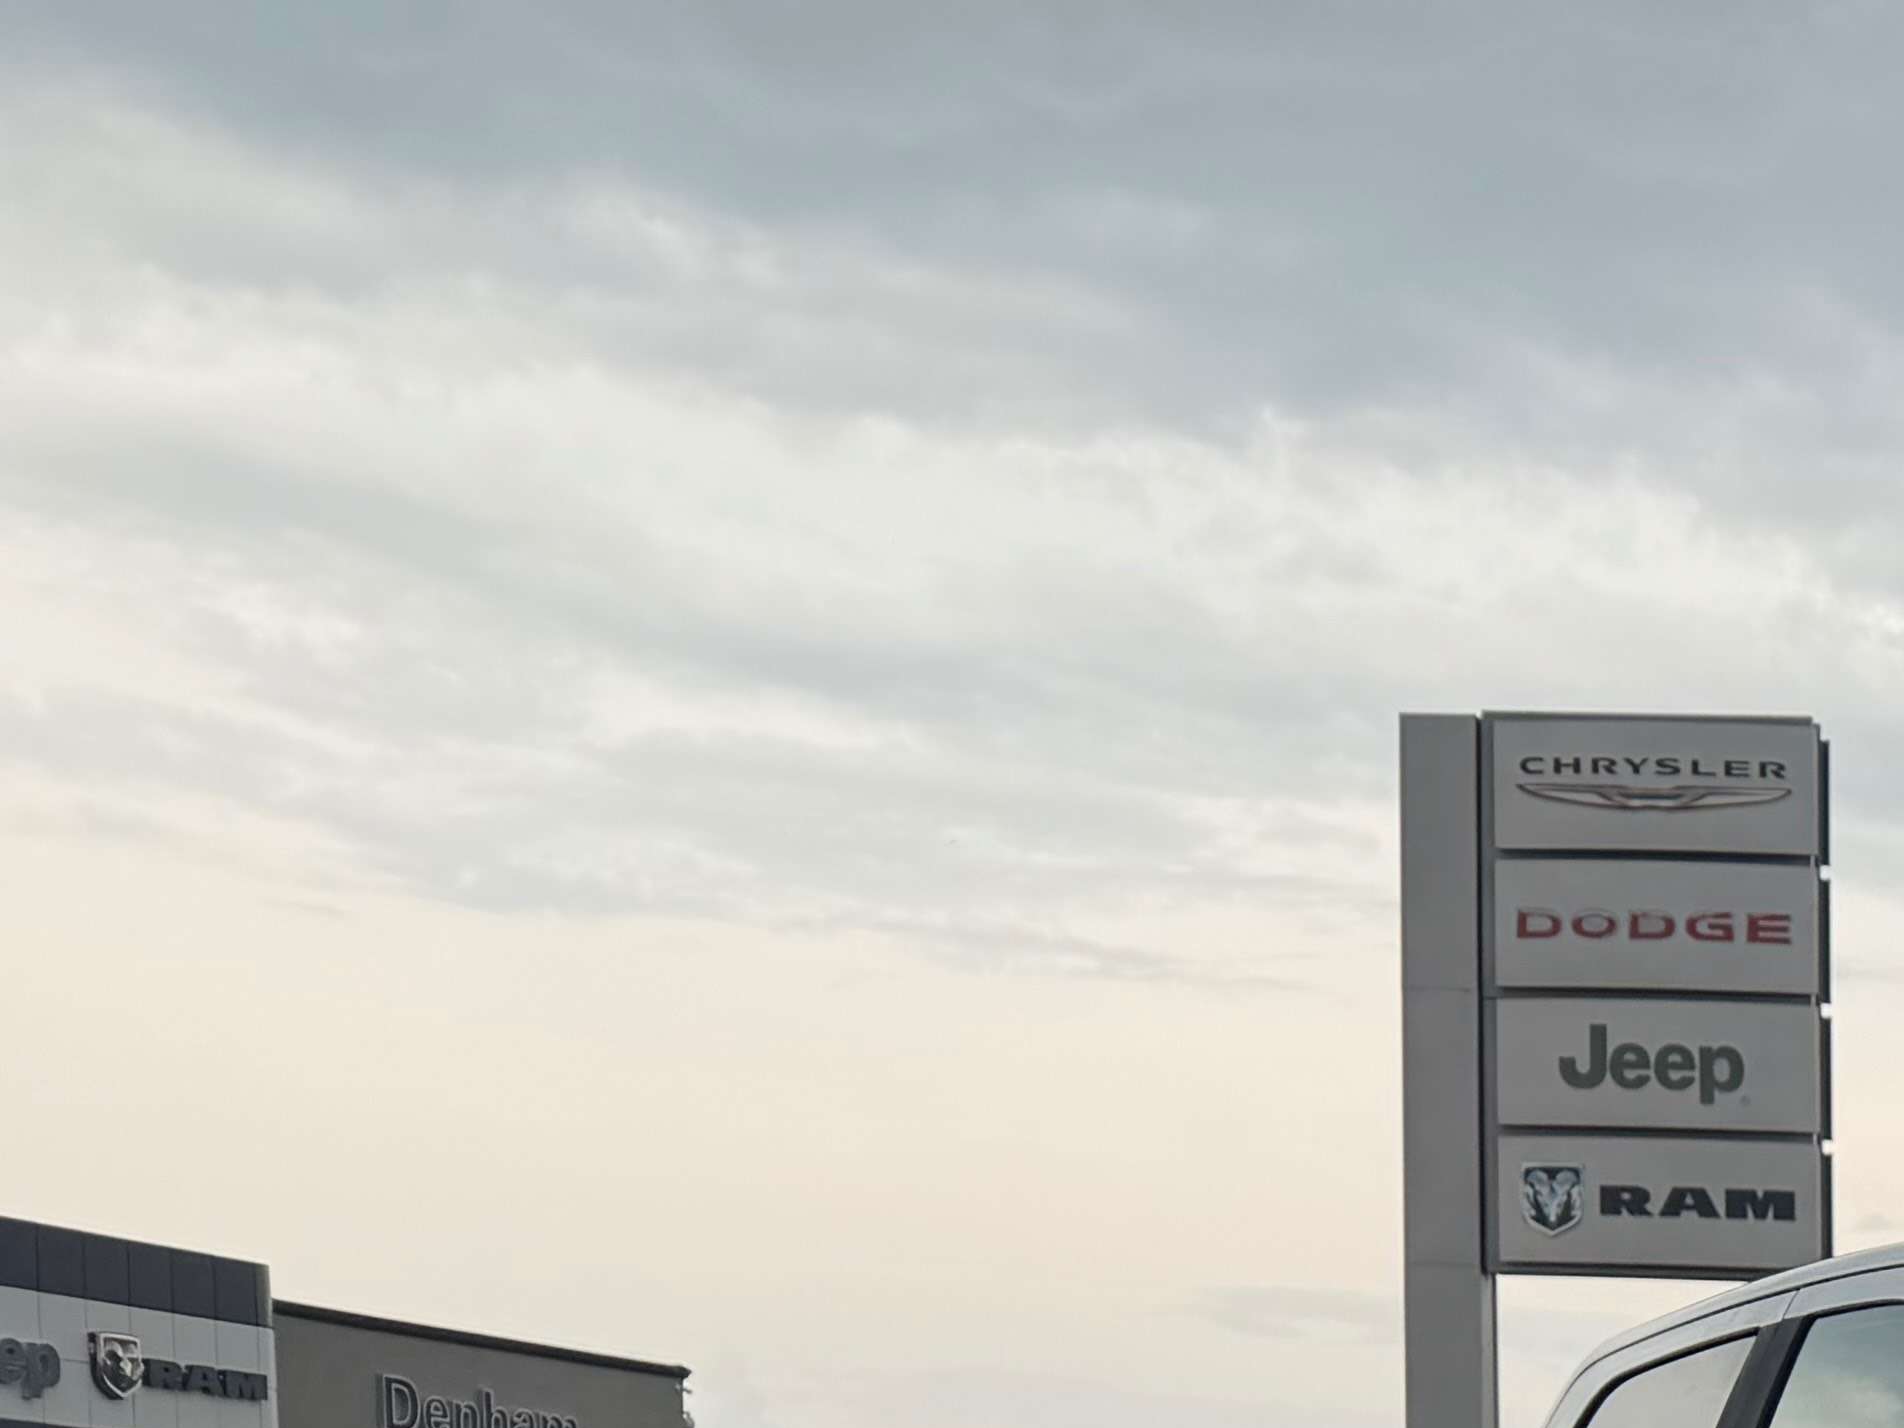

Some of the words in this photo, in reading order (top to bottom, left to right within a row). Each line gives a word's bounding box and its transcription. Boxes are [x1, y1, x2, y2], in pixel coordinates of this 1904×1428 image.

[1518, 755, 1788, 780] CHRYSLER
[1515, 905, 1794, 945] DODGE
[1558, 1023, 1745, 1105] Jeep
[1599, 1183, 1797, 1222] RAM
[142, 1356, 269, 1401] RAM
